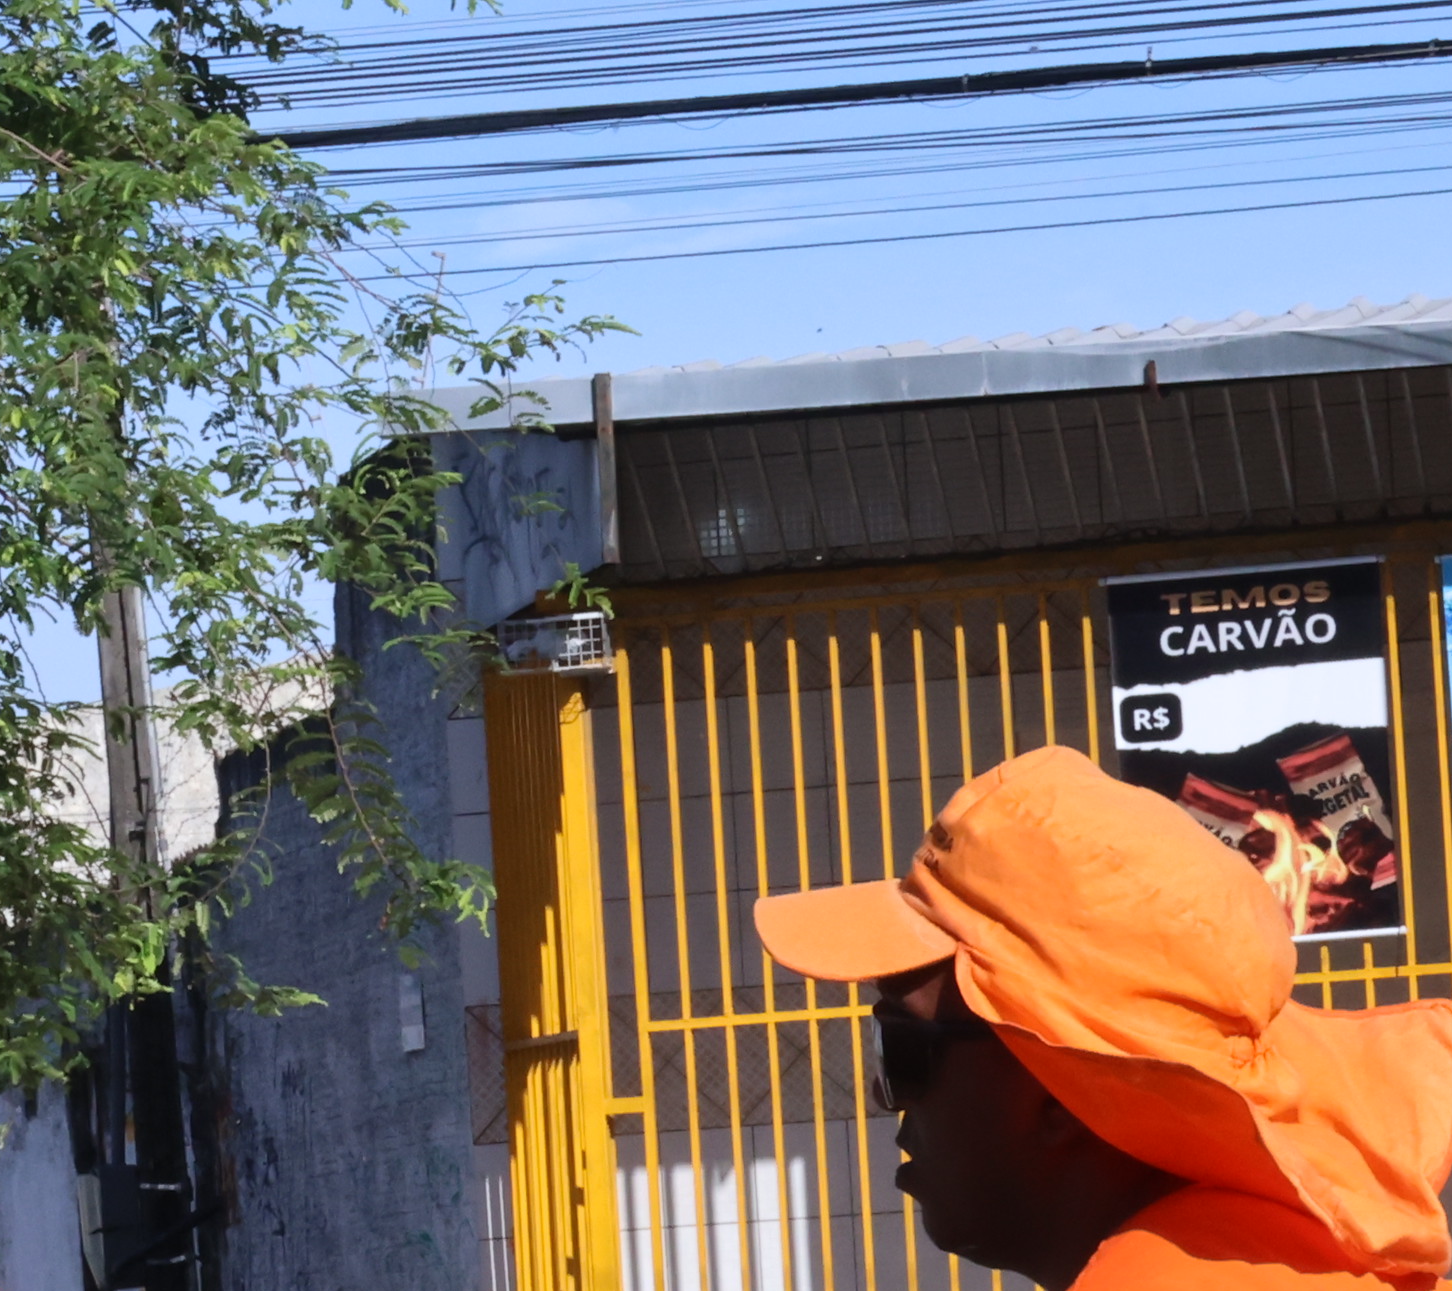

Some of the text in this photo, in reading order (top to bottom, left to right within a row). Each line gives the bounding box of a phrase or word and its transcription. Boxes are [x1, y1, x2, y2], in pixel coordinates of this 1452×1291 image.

[1159, 579, 1332, 616] TEMOS
[1159, 607, 1337, 658] CARVÃO
[1132, 706, 1171, 732] R$
[1308, 772, 1362, 799] ARVÃO
